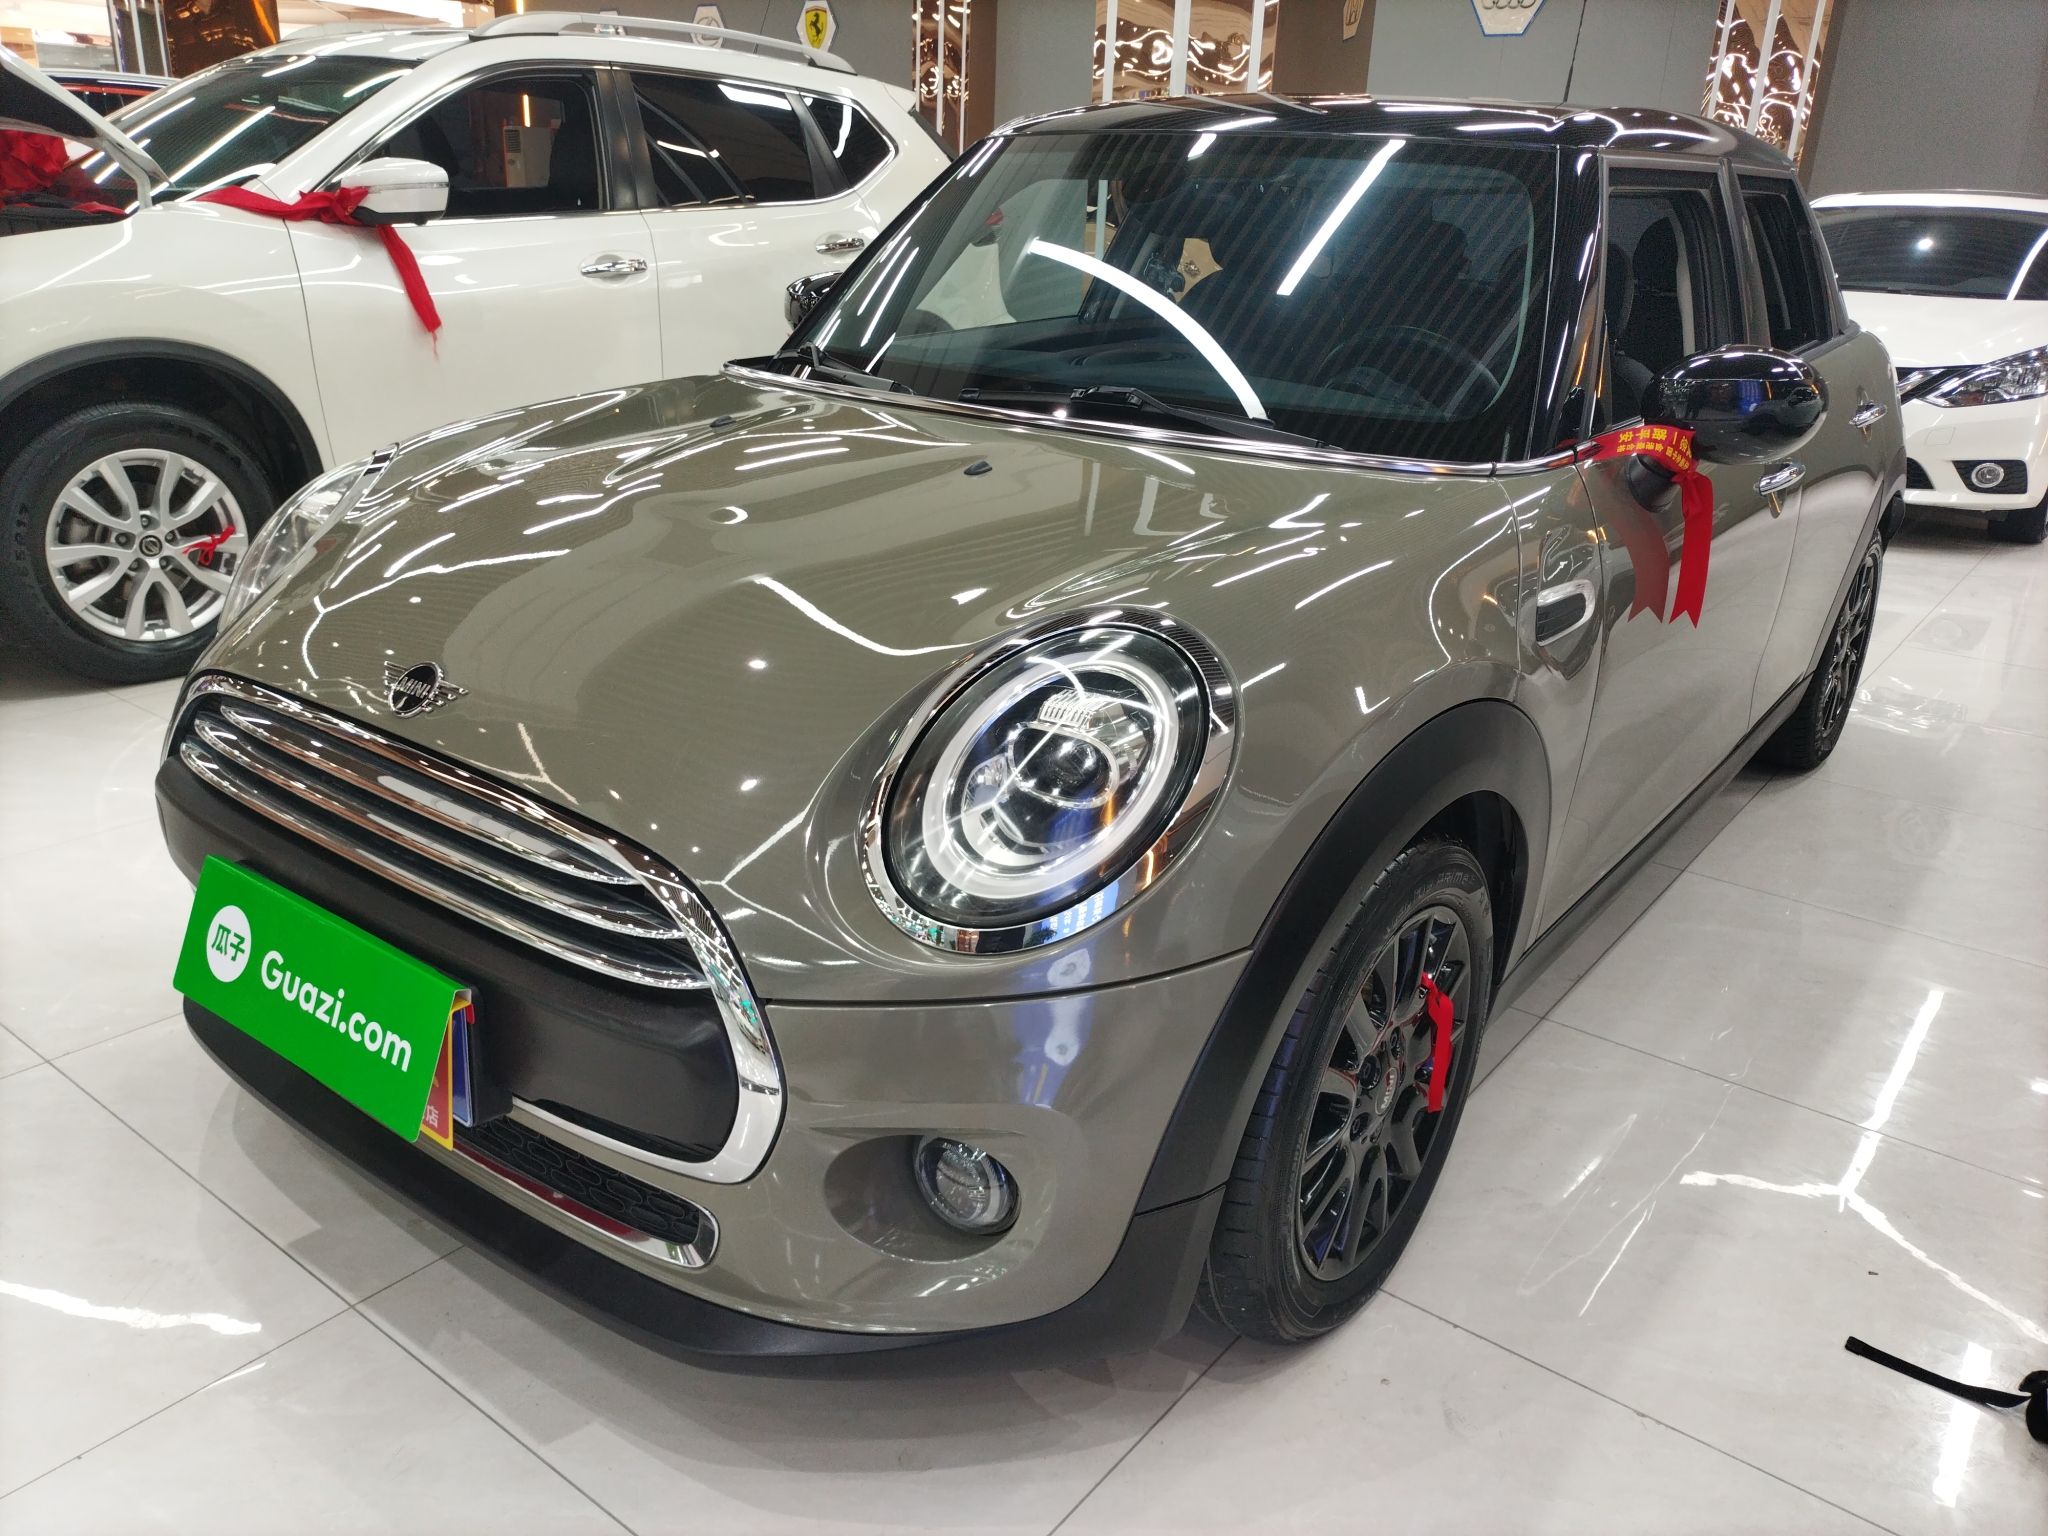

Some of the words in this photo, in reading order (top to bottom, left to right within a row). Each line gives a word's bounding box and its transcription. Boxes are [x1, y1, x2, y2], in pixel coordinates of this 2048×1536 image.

[397, 676, 432, 699] MINI
[211, 923, 246, 962] 瓜子
[261, 950, 412, 1073] Guazi.com
